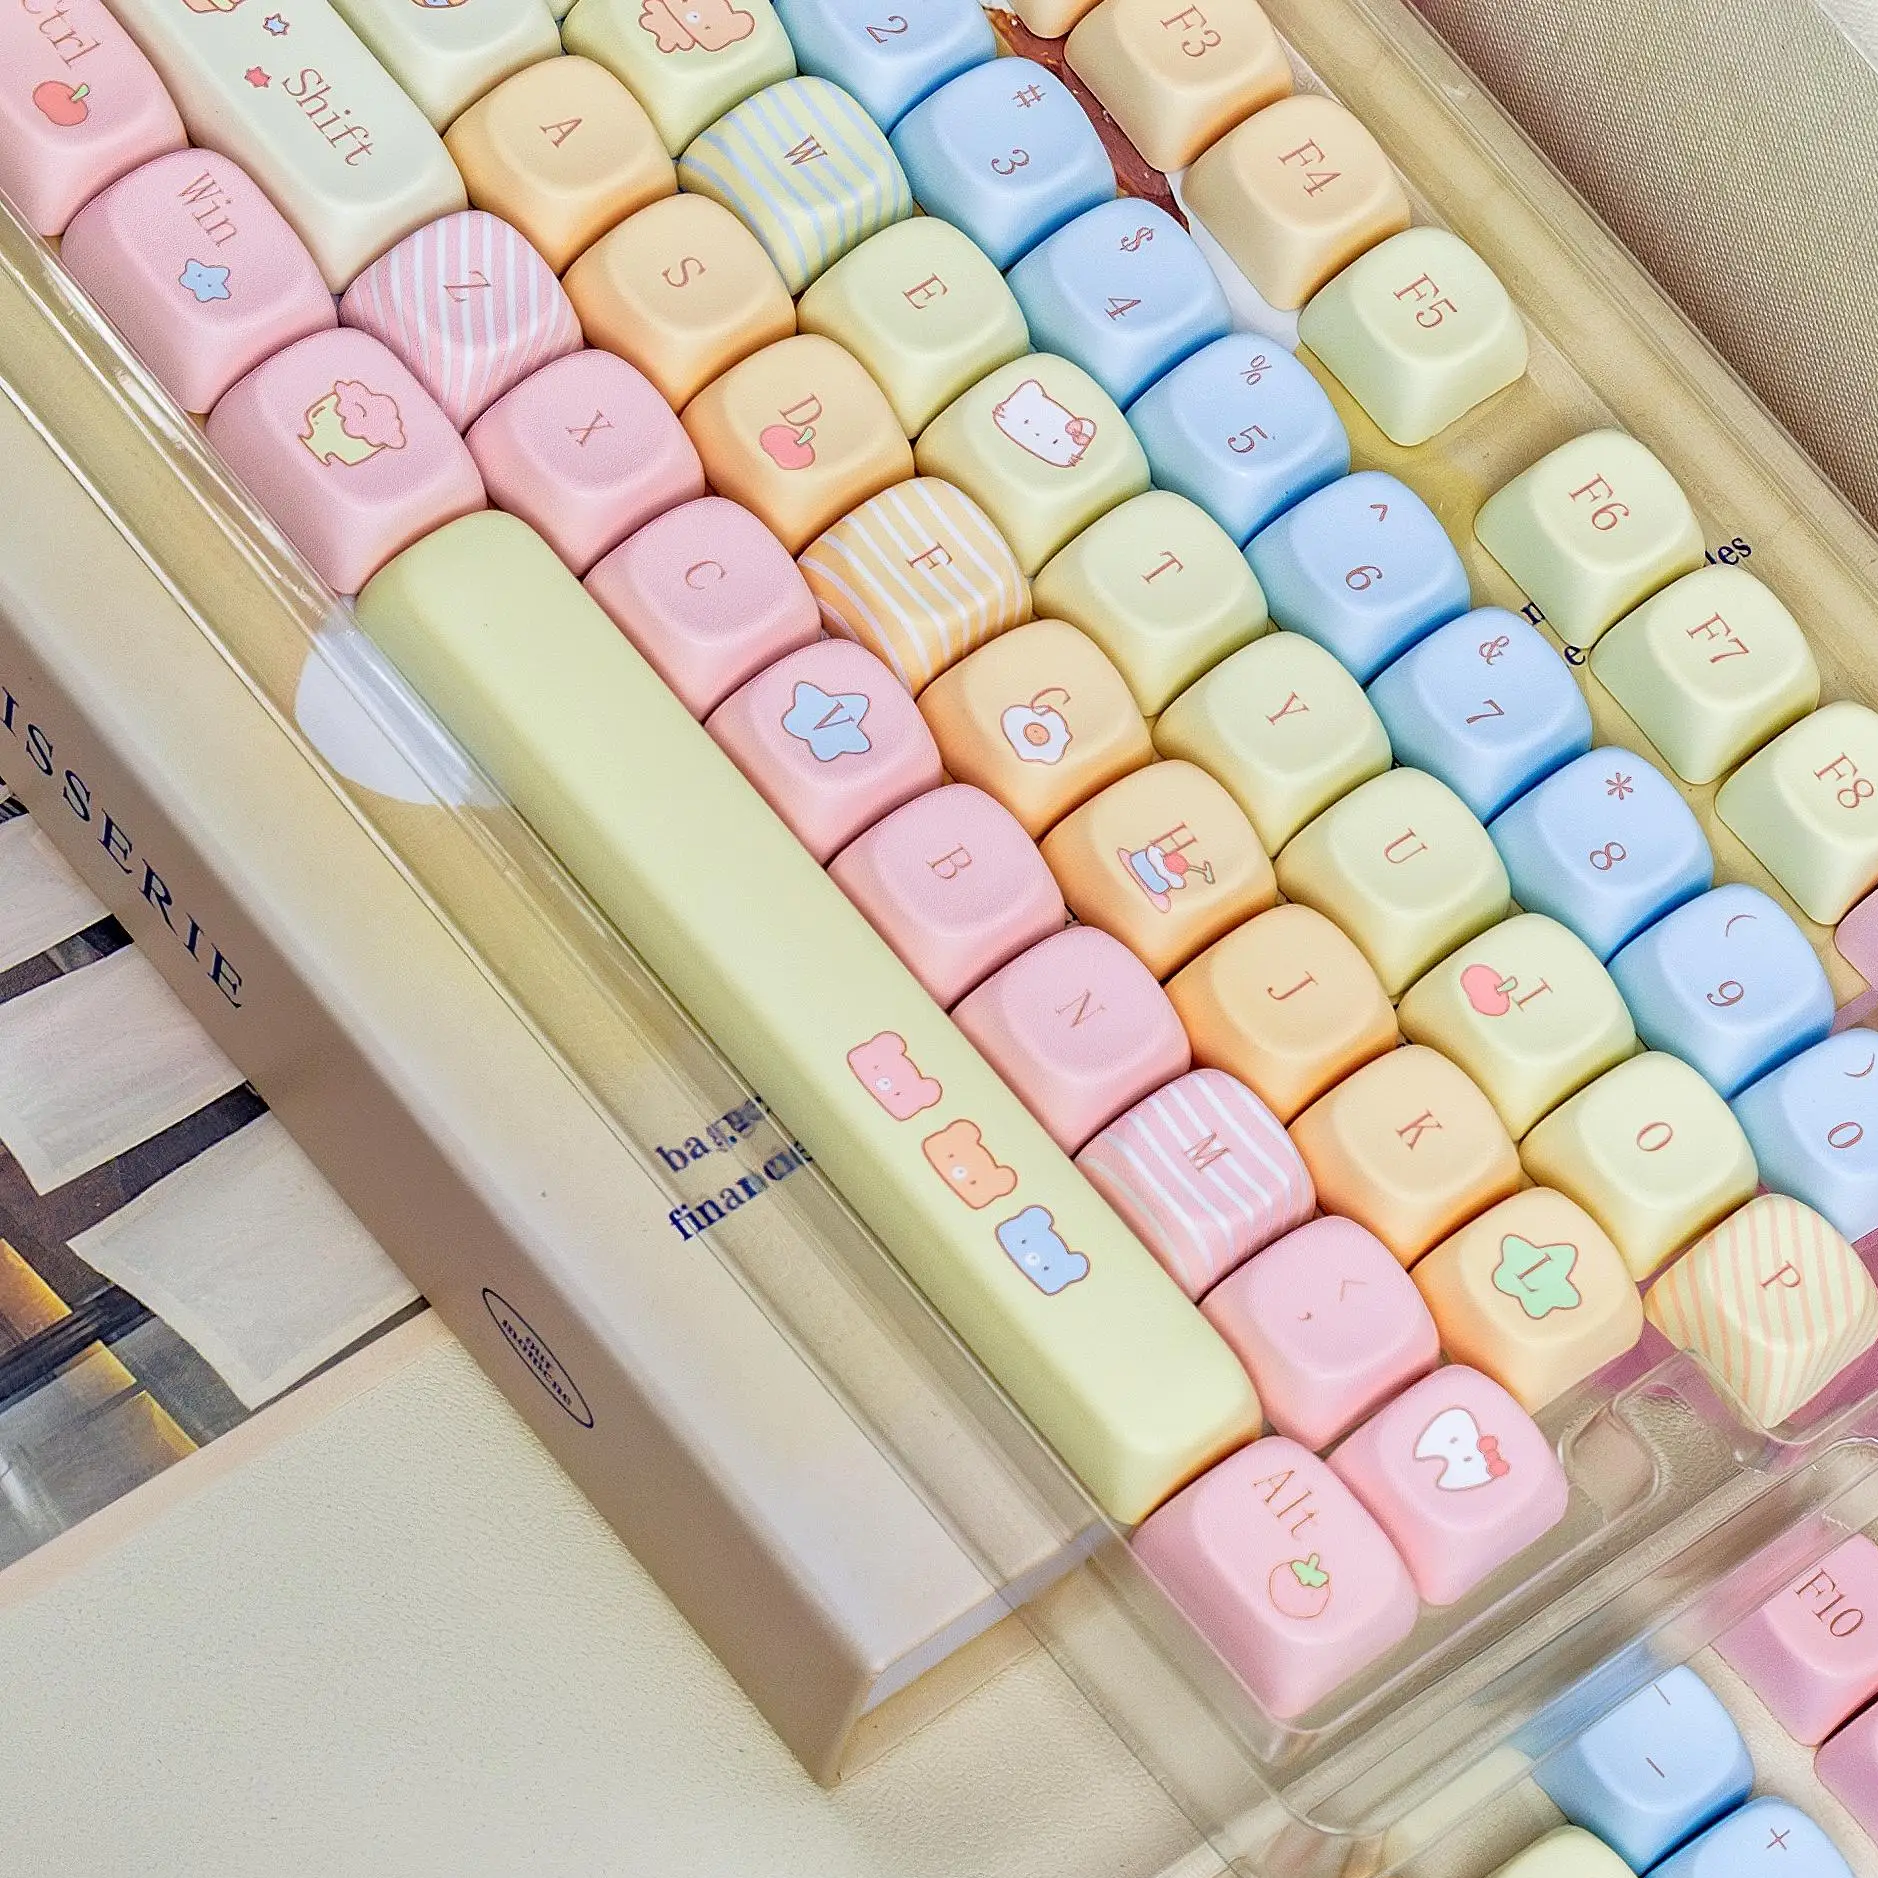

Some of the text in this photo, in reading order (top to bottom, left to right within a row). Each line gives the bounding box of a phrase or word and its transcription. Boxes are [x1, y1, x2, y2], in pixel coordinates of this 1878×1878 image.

[867, 16, 908, 44] 2
[1160, 4, 1221, 57] F3
[1012, 84, 1046, 108] #
[282, 60, 381, 166] Shift
[540, 118, 582, 148] A
[783, 134, 829, 168] W
[991, 149, 1029, 175] 3
[1278, 138, 1341, 197] F4
[178, 166, 244, 247] Win
[1120, 227, 1154, 252] $
[442, 270, 491, 303] Z
[662, 257, 706, 287] S
[902, 273, 948, 309] E
[1393, 273, 1457, 328] F5
[1105, 298, 1141, 321] 4
[1240, 355, 1272, 385] %
[778, 393, 824, 427] D
[565, 410, 614, 447] X
[1228, 425, 1268, 453] 5
[1569, 474, 1629, 531] F6
[906, 541, 954, 574] F
[1142, 551, 1183, 584] T
[685, 560, 726, 590] C
[1346, 566, 1383, 590] 6
[1479, 636, 1510, 666] &
[1686, 612, 1749, 663] F7
[812, 701, 856, 732] V
[1266, 692, 1309, 725] Y
[1466, 699, 1504, 724] 7
[1814, 752, 1874, 809] F8
[1384, 828, 1428, 864] U
[1589, 842, 1626, 870] 8
[927, 846, 972, 880] B
[1267, 971, 1316, 1001] J
[1706, 980, 1744, 1007] 9
[1055, 989, 1105, 1028] N
[1396, 1110, 1443, 1150] K
[1184, 1130, 1232, 1174] M
[1516, 1252, 1553, 1293] L
[1760, 1260, 1801, 1295] P
[1253, 1470, 1316, 1538] Alt
[1796, 1569, 1864, 1637] F10
